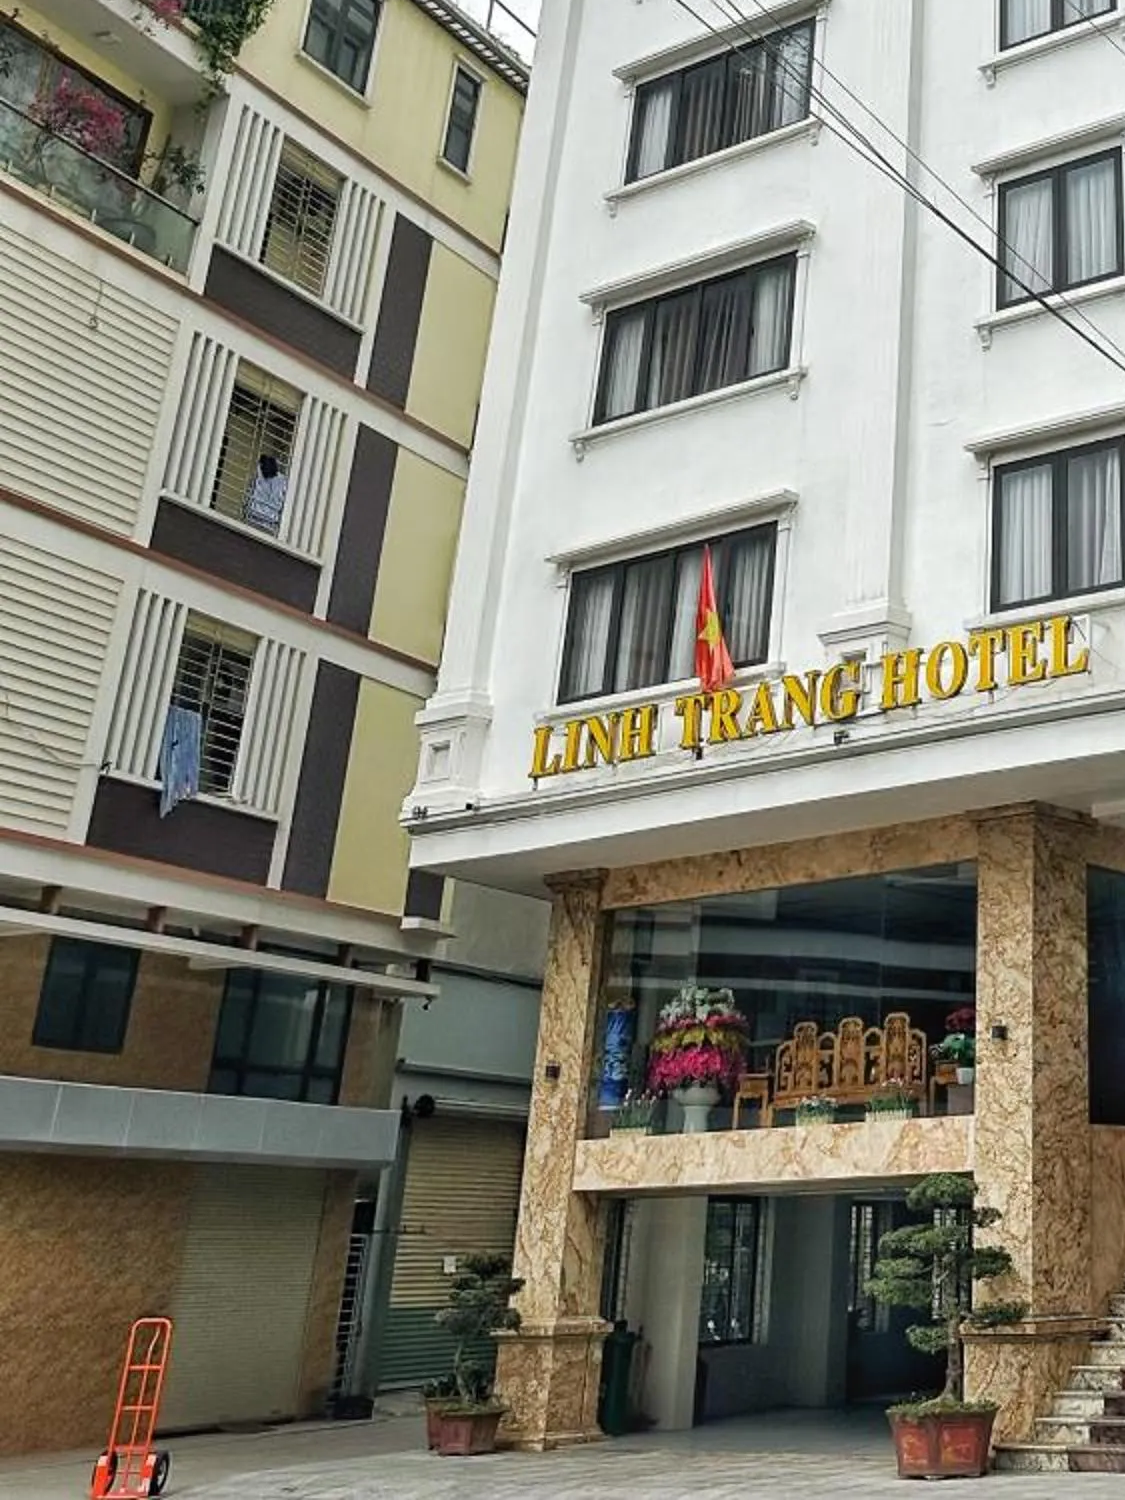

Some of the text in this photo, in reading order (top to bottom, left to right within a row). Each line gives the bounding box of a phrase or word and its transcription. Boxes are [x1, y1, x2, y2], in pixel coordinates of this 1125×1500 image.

[528, 615, 1091, 778] LINH TRANG HOTEL
